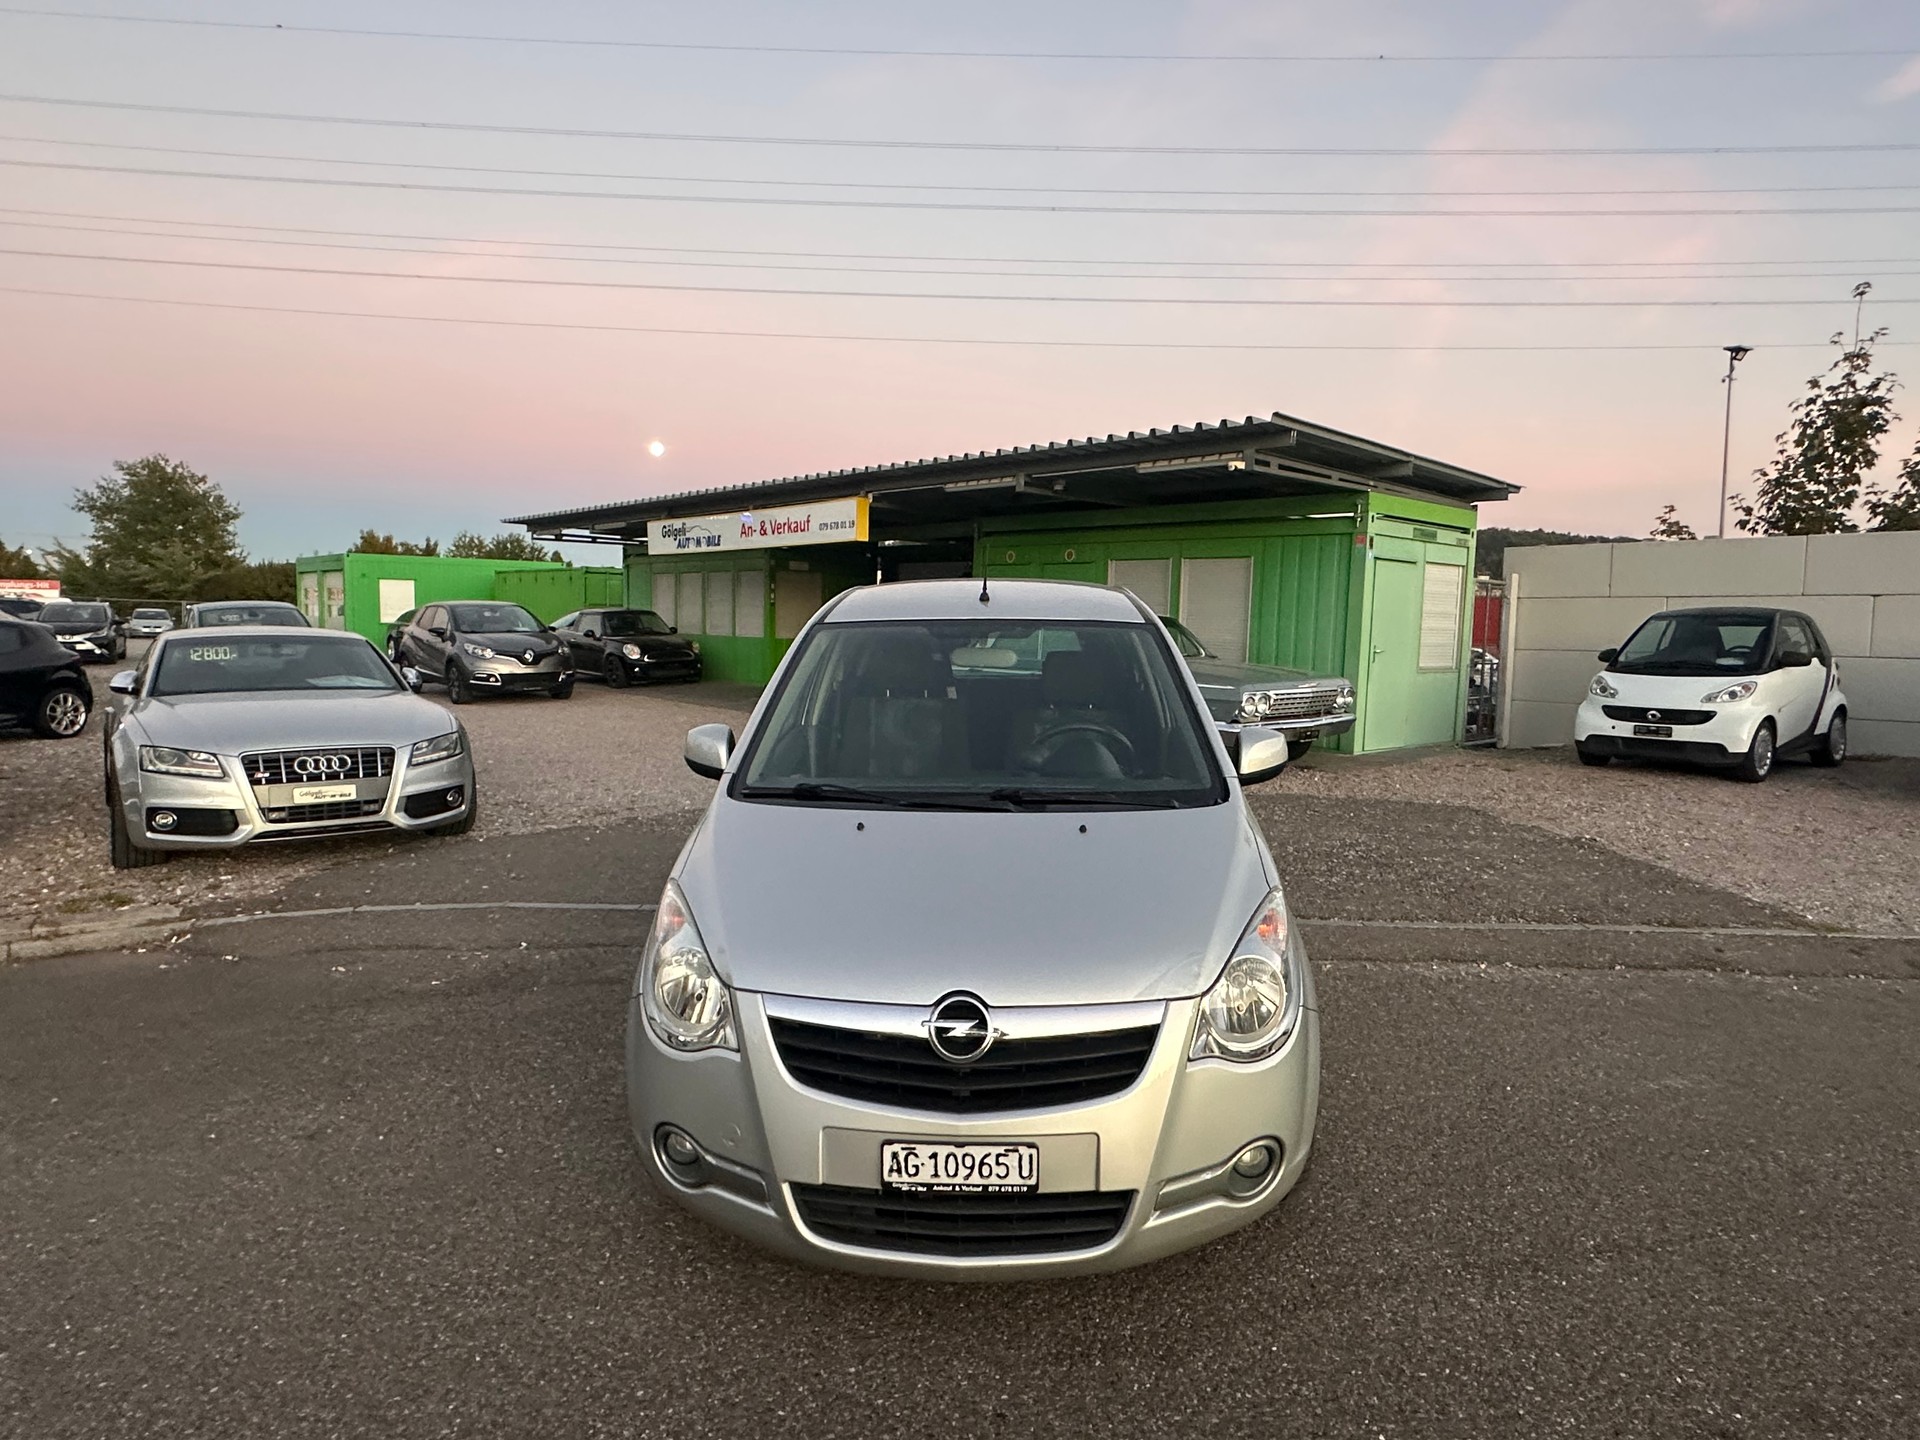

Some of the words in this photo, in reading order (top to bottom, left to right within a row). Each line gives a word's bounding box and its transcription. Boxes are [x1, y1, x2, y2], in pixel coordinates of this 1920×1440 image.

[740, 523, 757, 538] An-
[760, 520, 768, 536] &
[769, 514, 811, 536] Verkauf
[819, 522, 829, 531] 079
[829, 521, 839, 530] 678
[840, 520, 847, 529] 01
